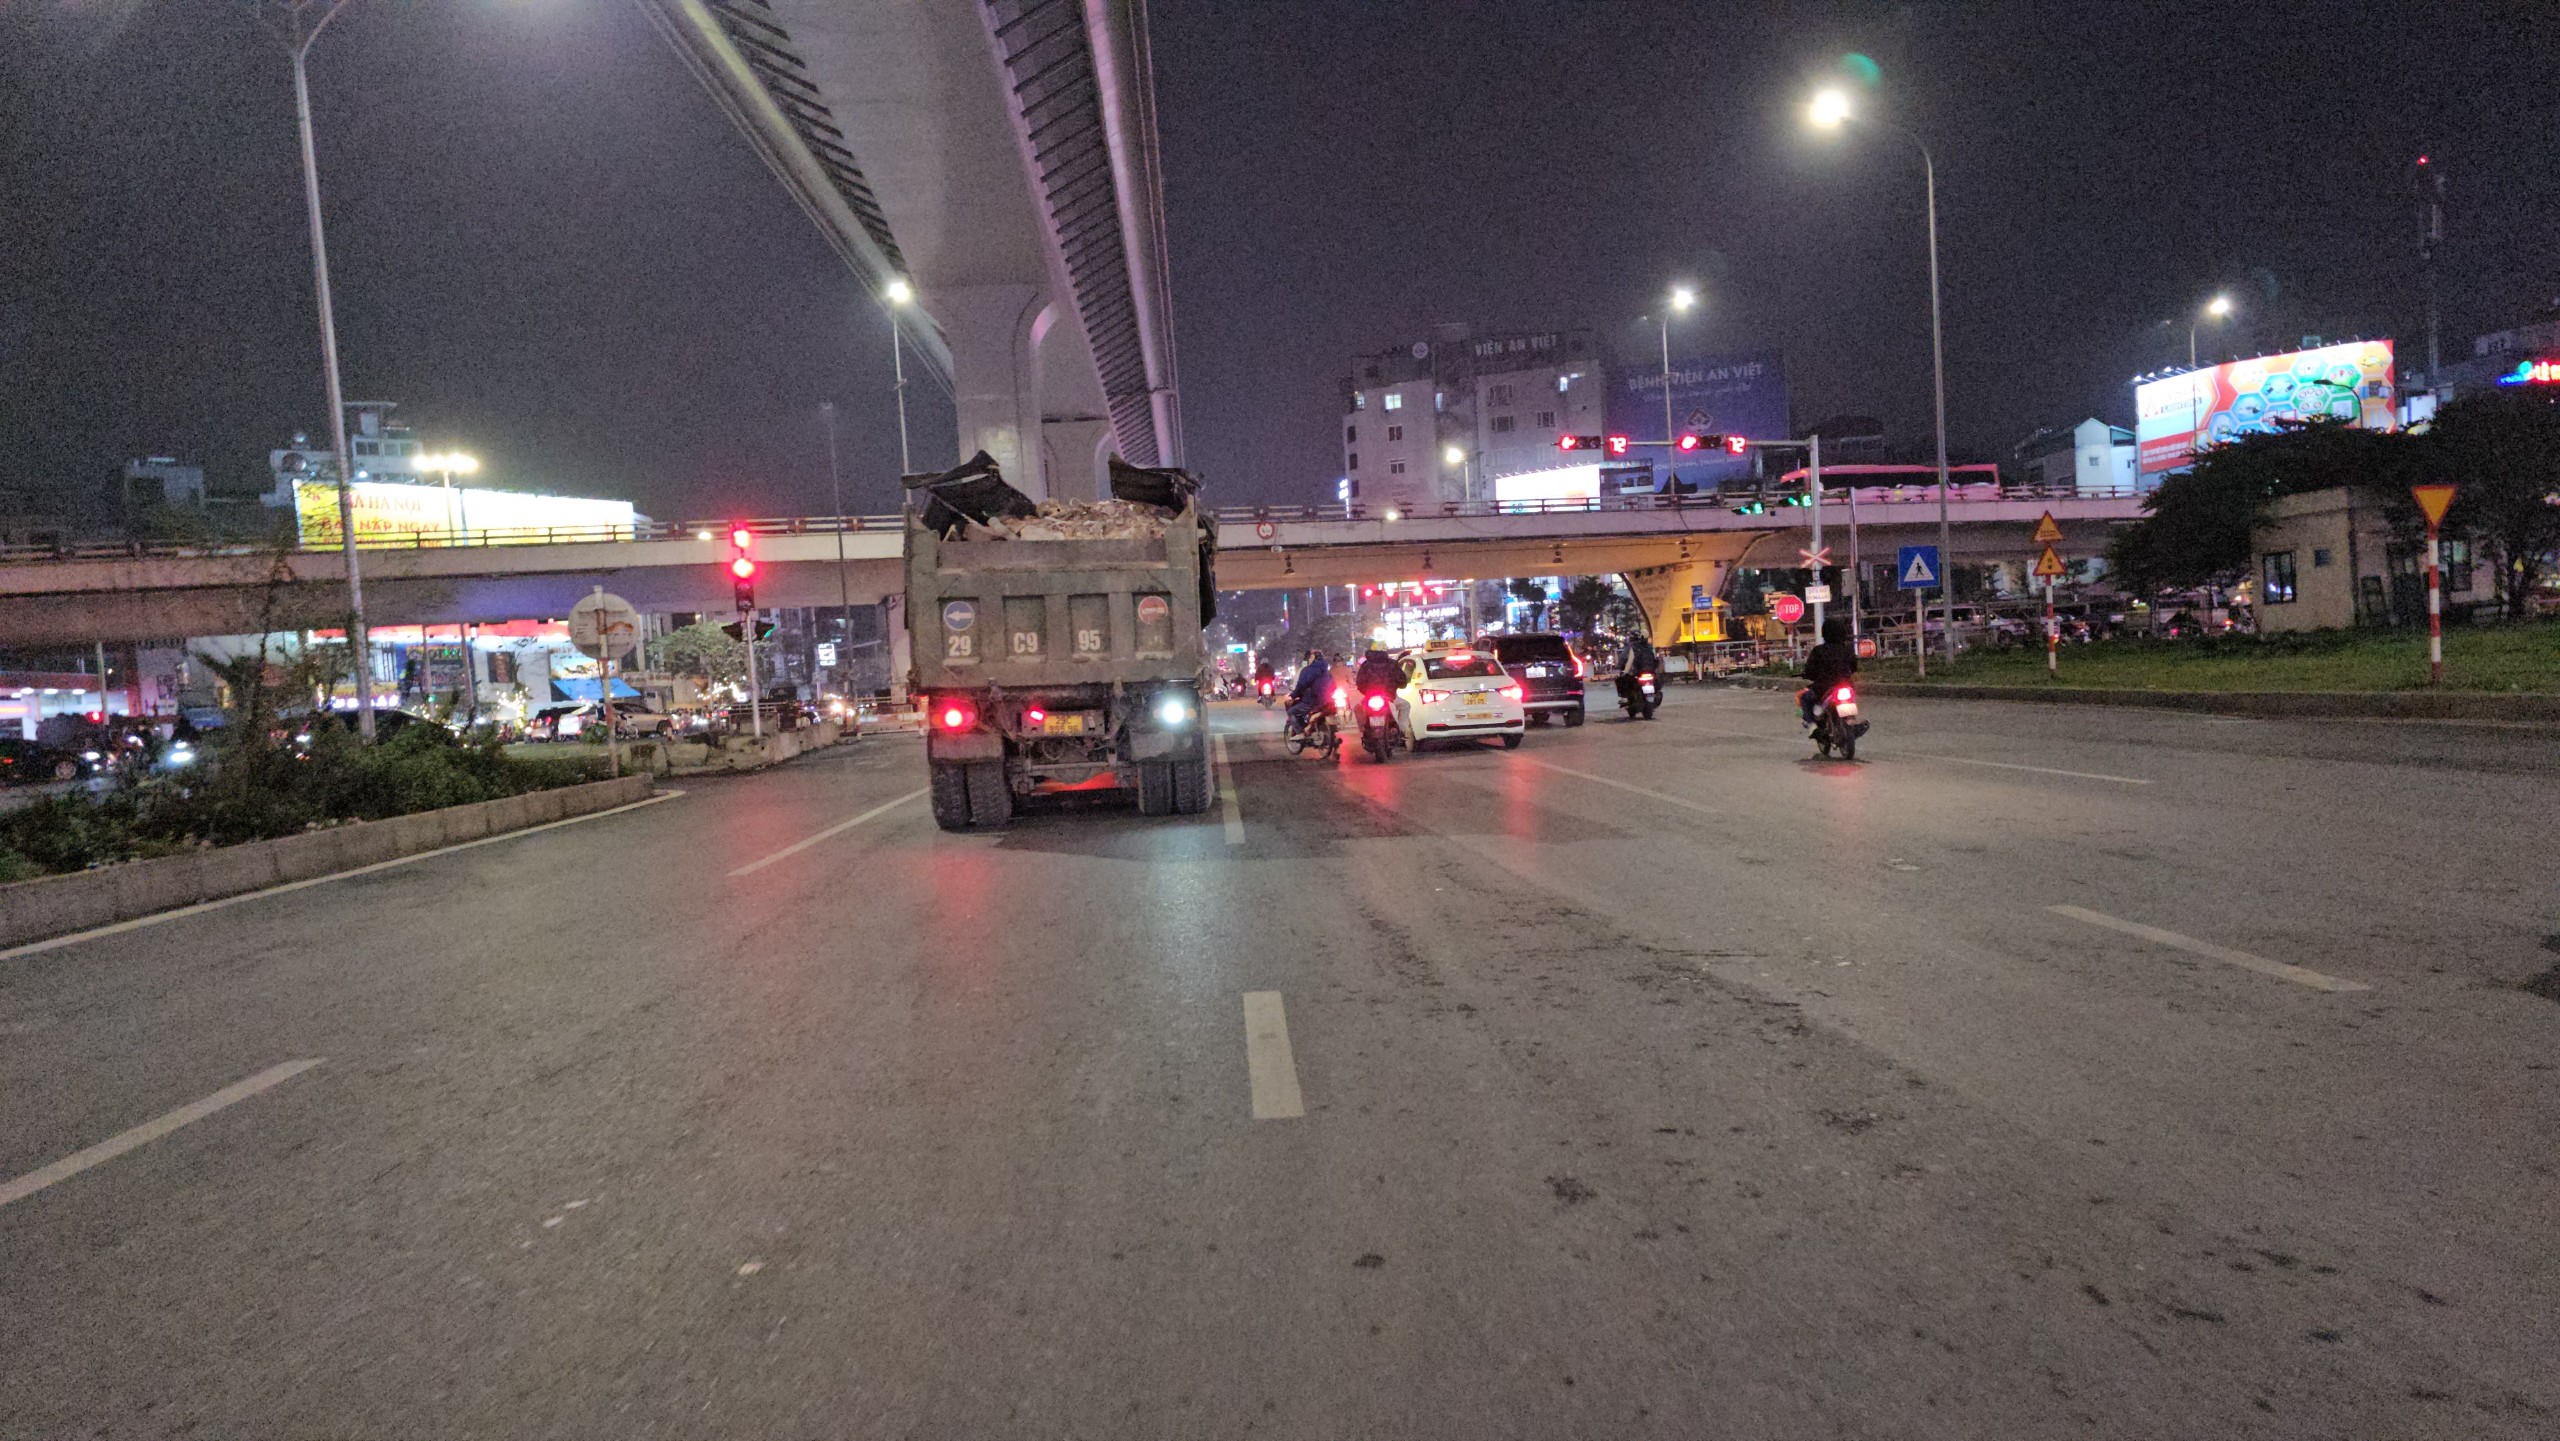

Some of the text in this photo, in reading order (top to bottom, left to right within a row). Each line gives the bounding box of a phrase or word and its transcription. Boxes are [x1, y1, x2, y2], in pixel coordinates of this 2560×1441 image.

[1707, 367, 1729, 381] AN
[1609, 436, 1627, 453] 72
[1728, 436, 1744, 453] 72
[948, 629, 1101, 657] 29 C9 95
